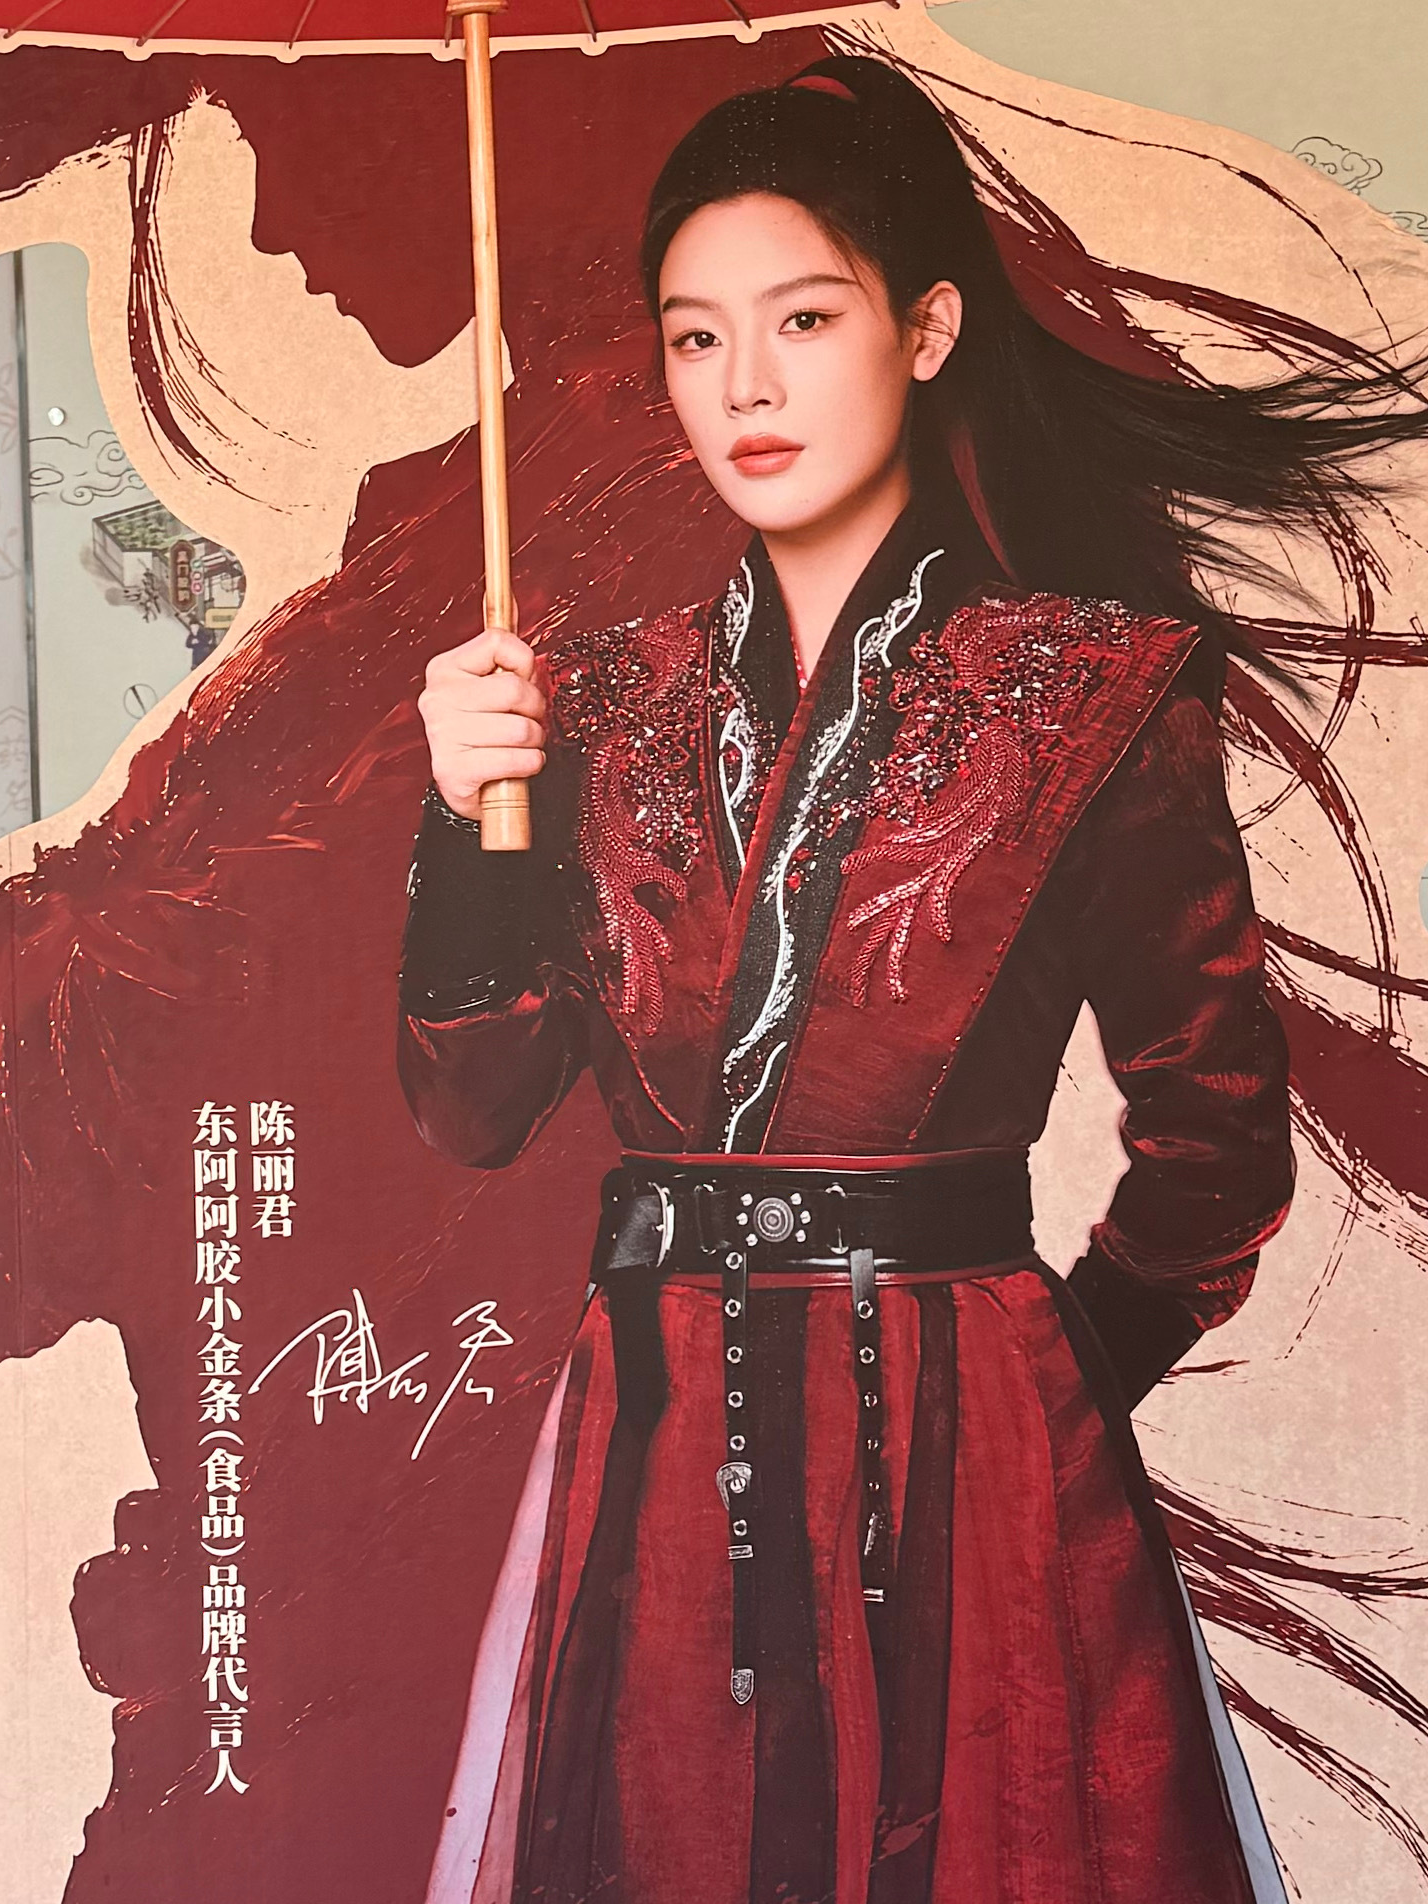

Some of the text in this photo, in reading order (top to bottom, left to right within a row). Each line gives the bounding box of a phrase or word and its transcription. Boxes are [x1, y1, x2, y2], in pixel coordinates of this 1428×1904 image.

[250, 1100, 296, 1239] 陈丽君
[191, 1100, 250, 1797] 东阿阿胶小金条（食品）品牌代言人
